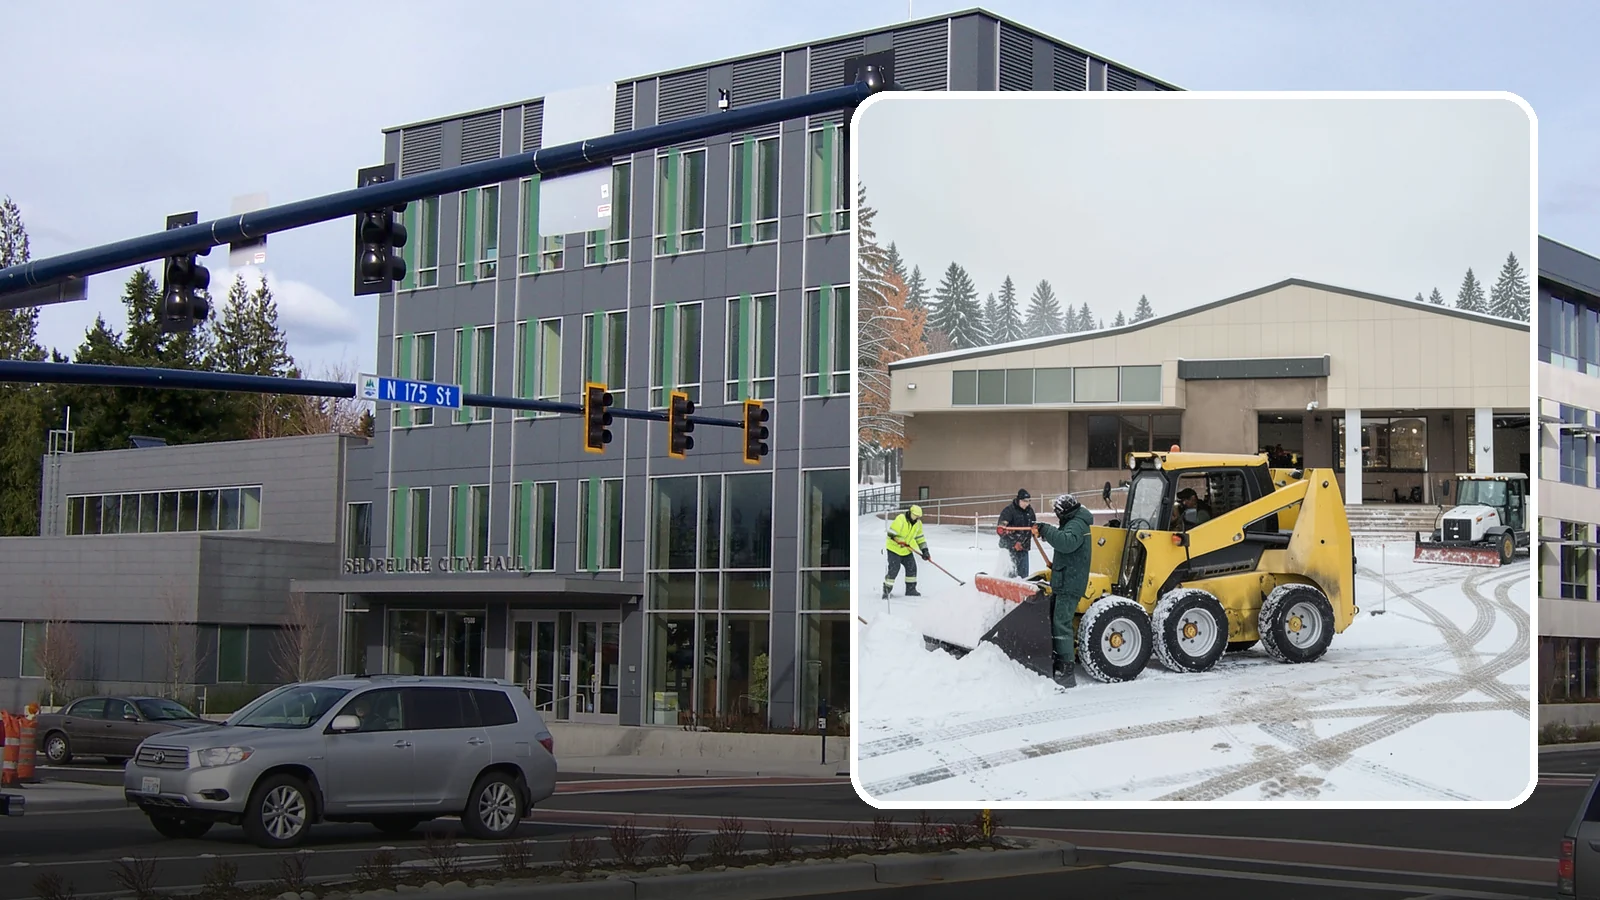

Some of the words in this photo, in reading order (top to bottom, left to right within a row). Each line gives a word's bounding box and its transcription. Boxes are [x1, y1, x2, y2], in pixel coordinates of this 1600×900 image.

[387, 380, 396, 400] N
[405, 382, 428, 403] 175
[436, 386, 451, 406] St
[344, 556, 432, 574] SHORELINE
[438, 555, 475, 572] CITY
[484, 555, 525, 572] HALL
